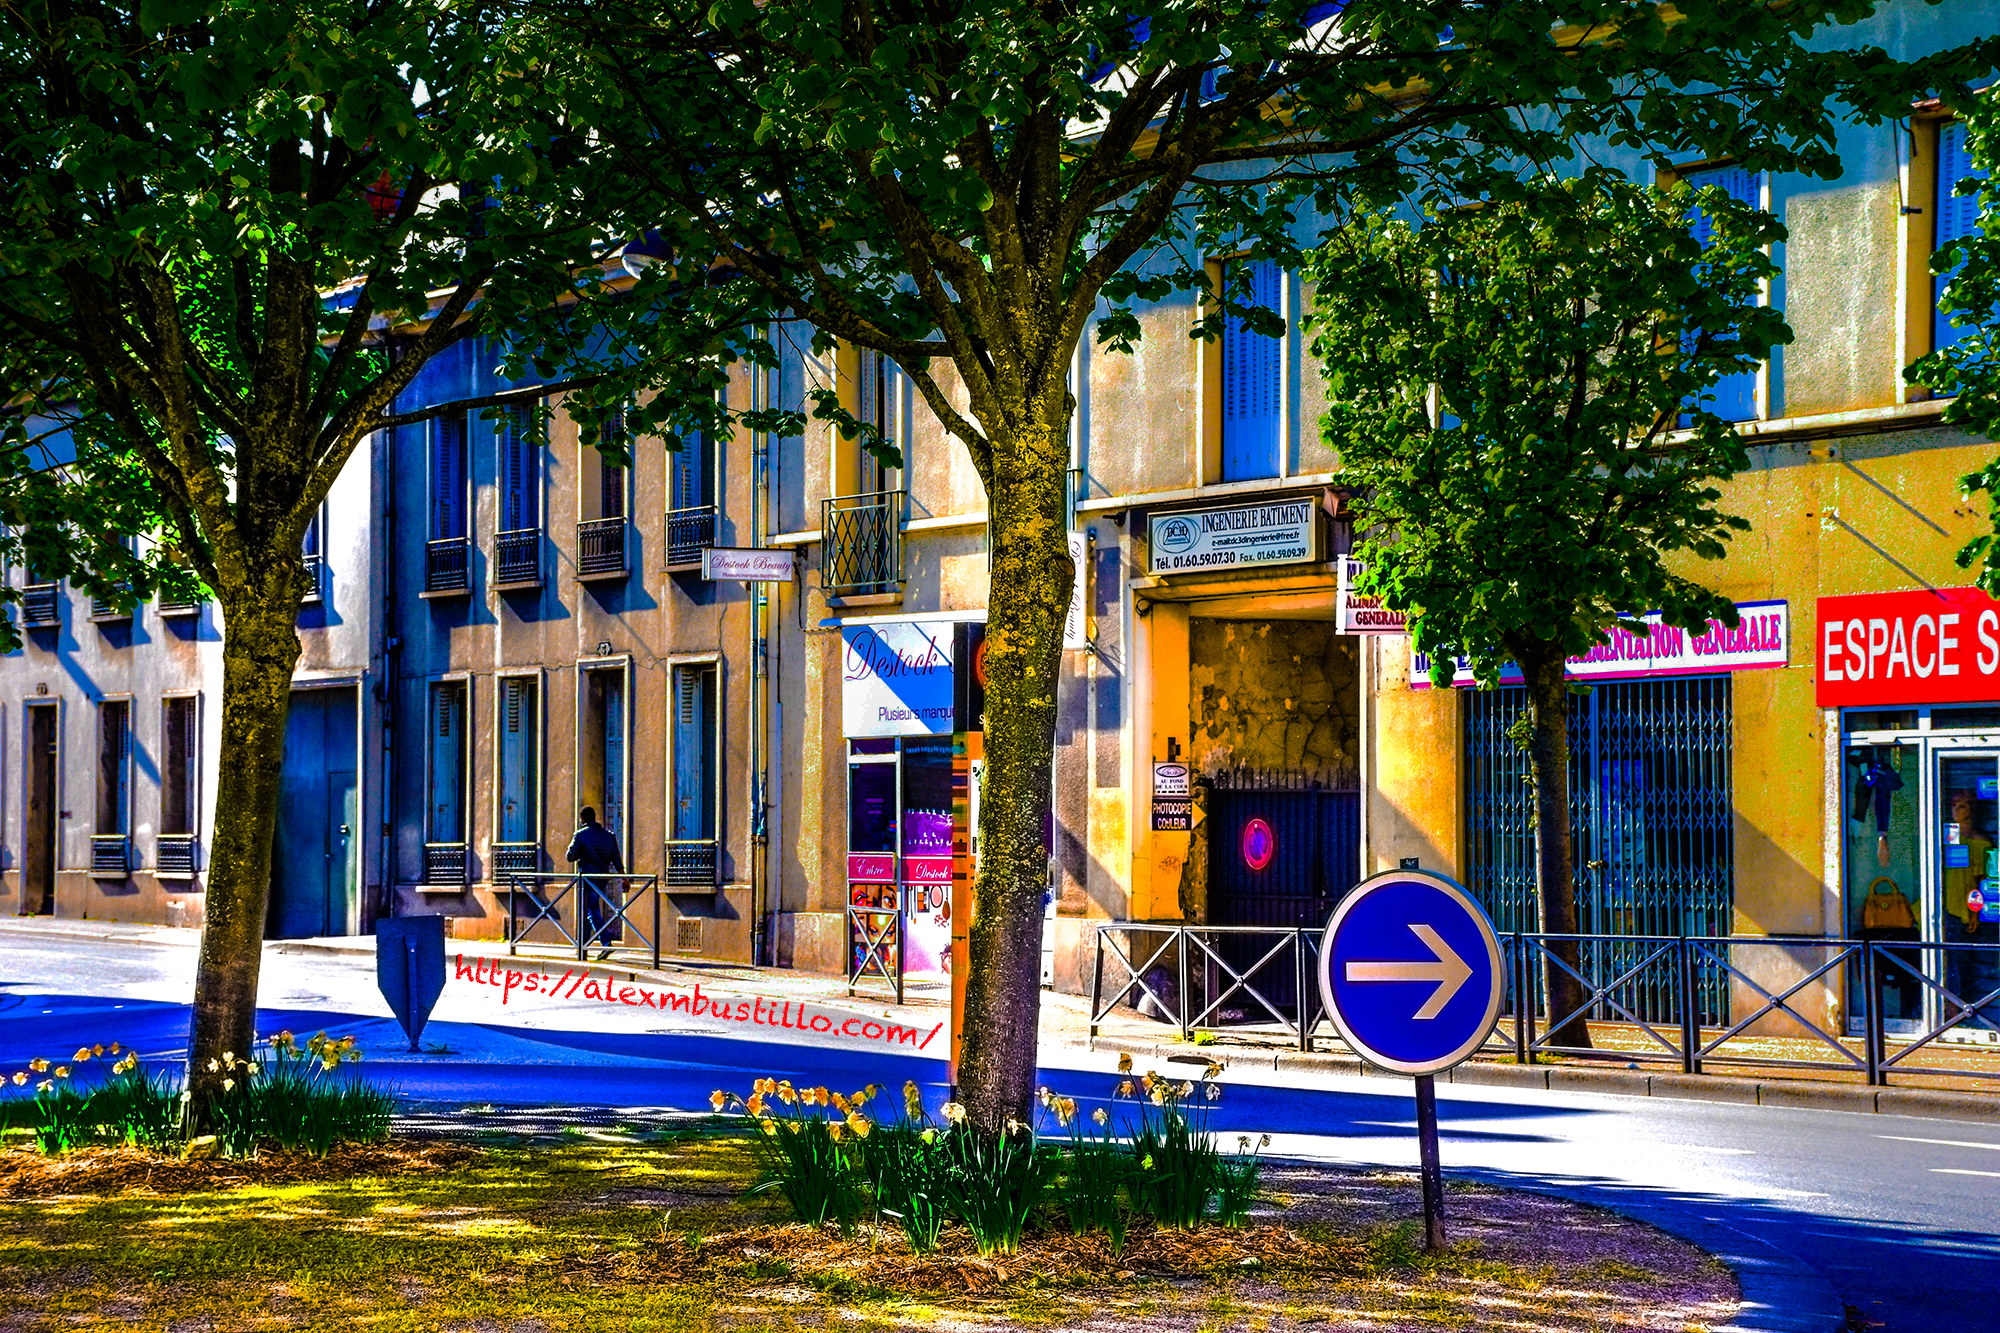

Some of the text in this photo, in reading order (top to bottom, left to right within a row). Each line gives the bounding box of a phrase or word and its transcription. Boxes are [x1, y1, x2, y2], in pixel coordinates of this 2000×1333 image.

[1201, 503, 1310, 533] INGENIERIE BATIMENT
[711, 554, 791, 575] Destock Beauty
[1155, 547, 1307, 570] Tél. 01.60.59.07.30 Fax. 01.60.59.09.39
[844, 629, 939, 682] Destock
[1824, 613, 1960, 681] ESPACE
[878, 705, 920, 722] Plusieurs
[1153, 802, 1192, 815] PHOTOCOPIE
[1157, 817, 1187, 830] COULEUR
[915, 862, 948, 879] Destock
